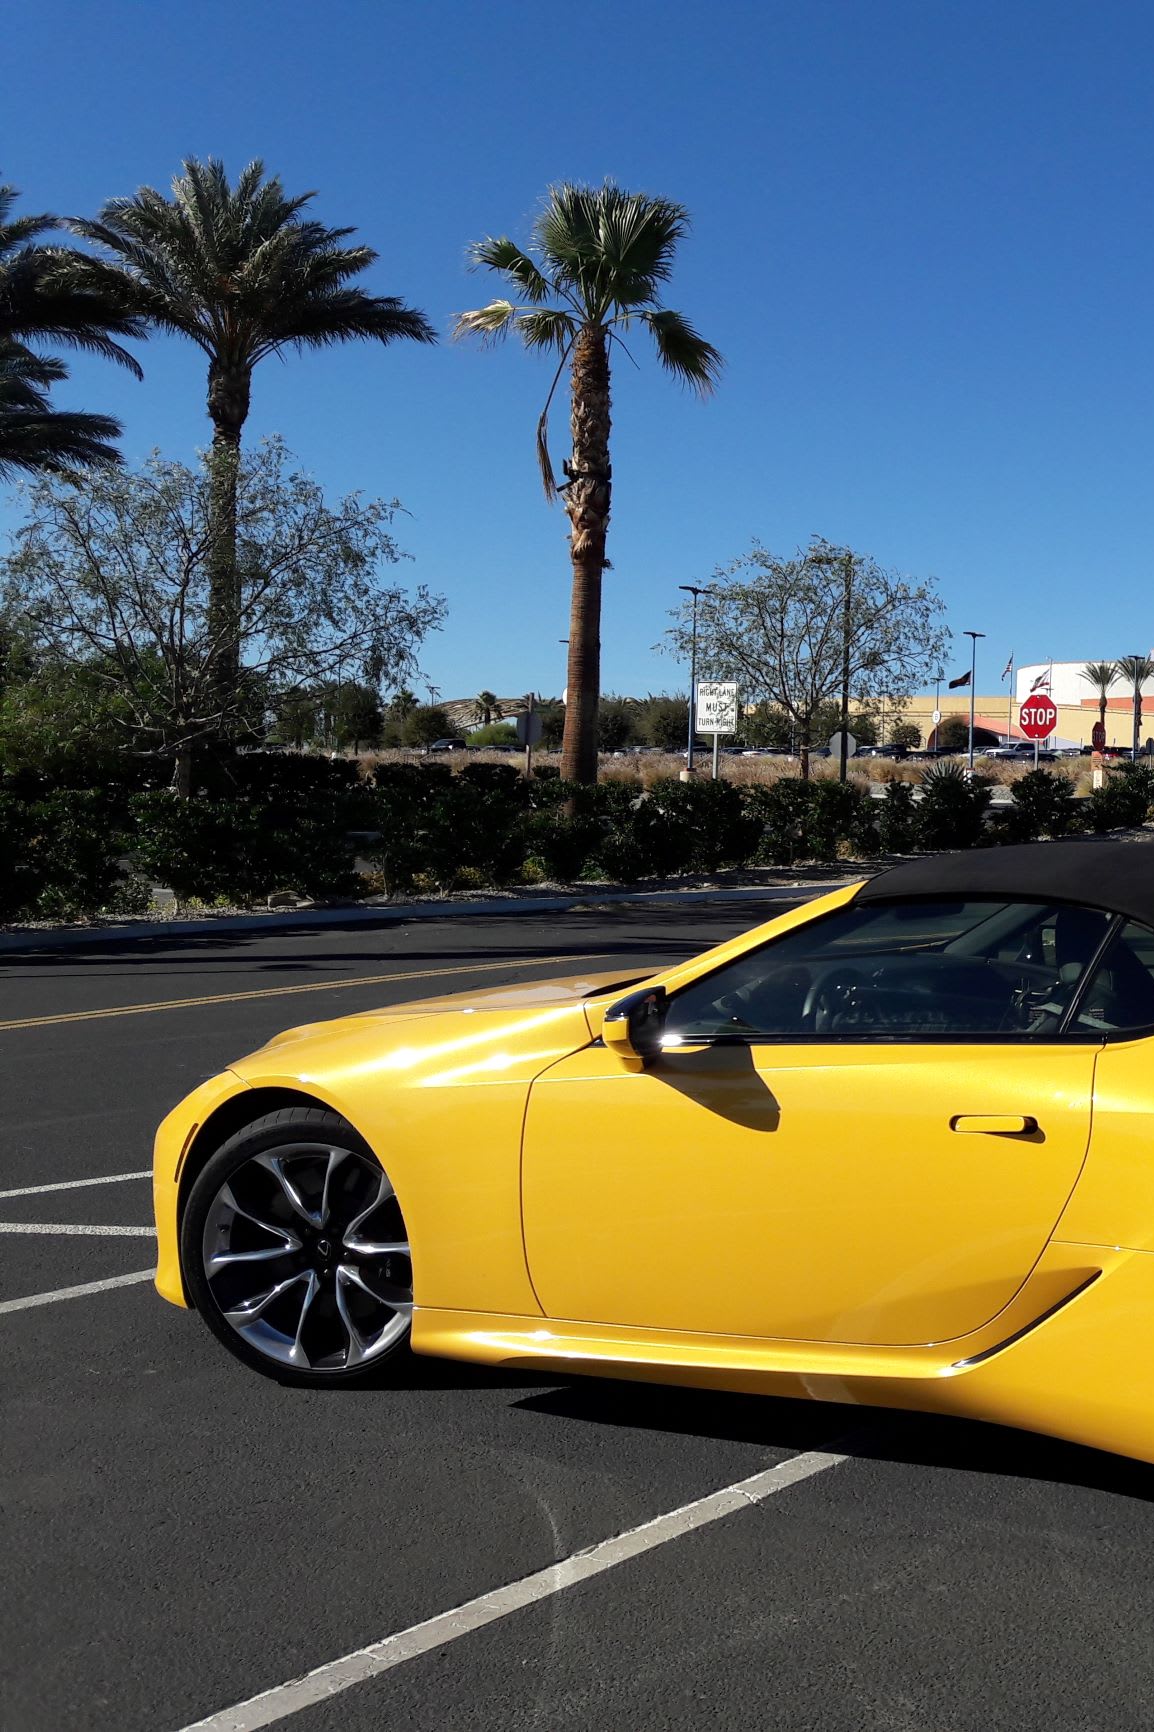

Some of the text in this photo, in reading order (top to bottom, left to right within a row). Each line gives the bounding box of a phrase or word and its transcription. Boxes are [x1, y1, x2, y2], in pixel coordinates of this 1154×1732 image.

[700, 688, 735, 697] RIGHT LANE
[706, 702, 729, 713] MUST
[1021, 708, 1055, 725] STOP
[698, 718, 714, 726] TURN
